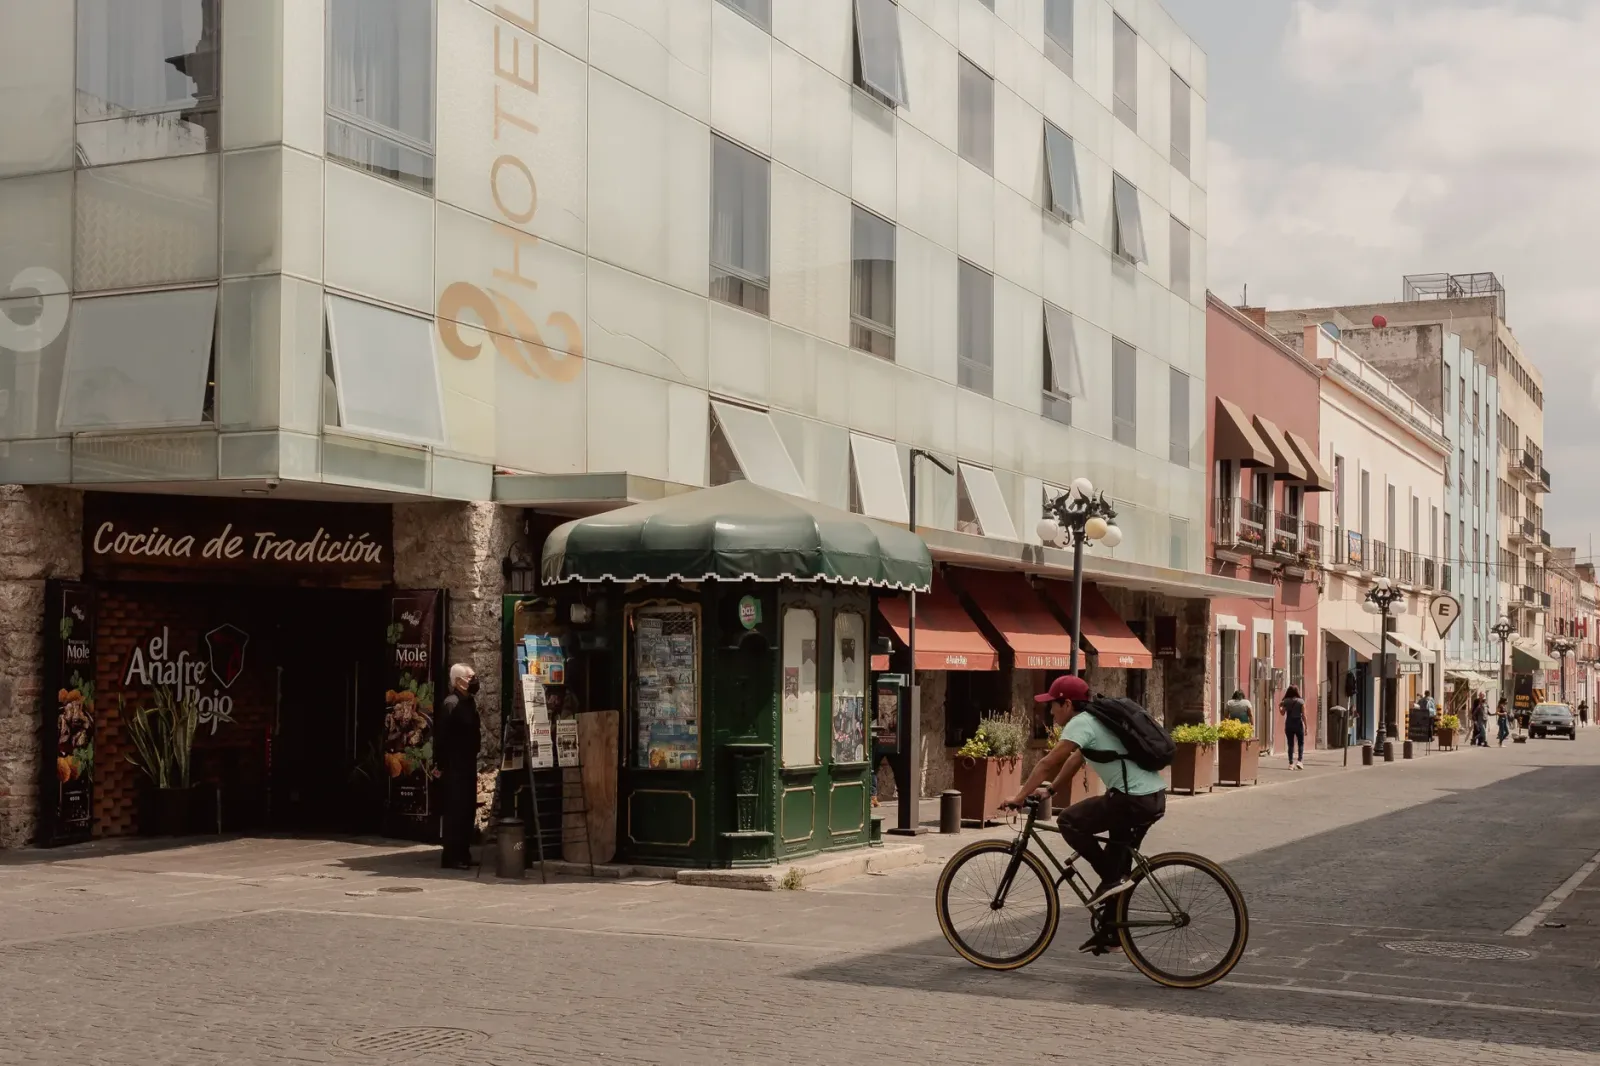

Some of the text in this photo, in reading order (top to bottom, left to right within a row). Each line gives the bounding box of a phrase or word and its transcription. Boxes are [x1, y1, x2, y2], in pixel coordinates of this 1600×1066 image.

[490, 0, 539, 291] HOTEL
[93, 521, 382, 564] Cocina de Tradición
[740, 604, 755, 616] baz
[1438, 603, 1450, 616] E
[1575, 617, 1588, 638] H
[67, 644, 90, 659] Mole
[149, 625, 169, 661] el
[396, 648, 428, 662] Mole
[124, 646, 206, 702] Anafre
